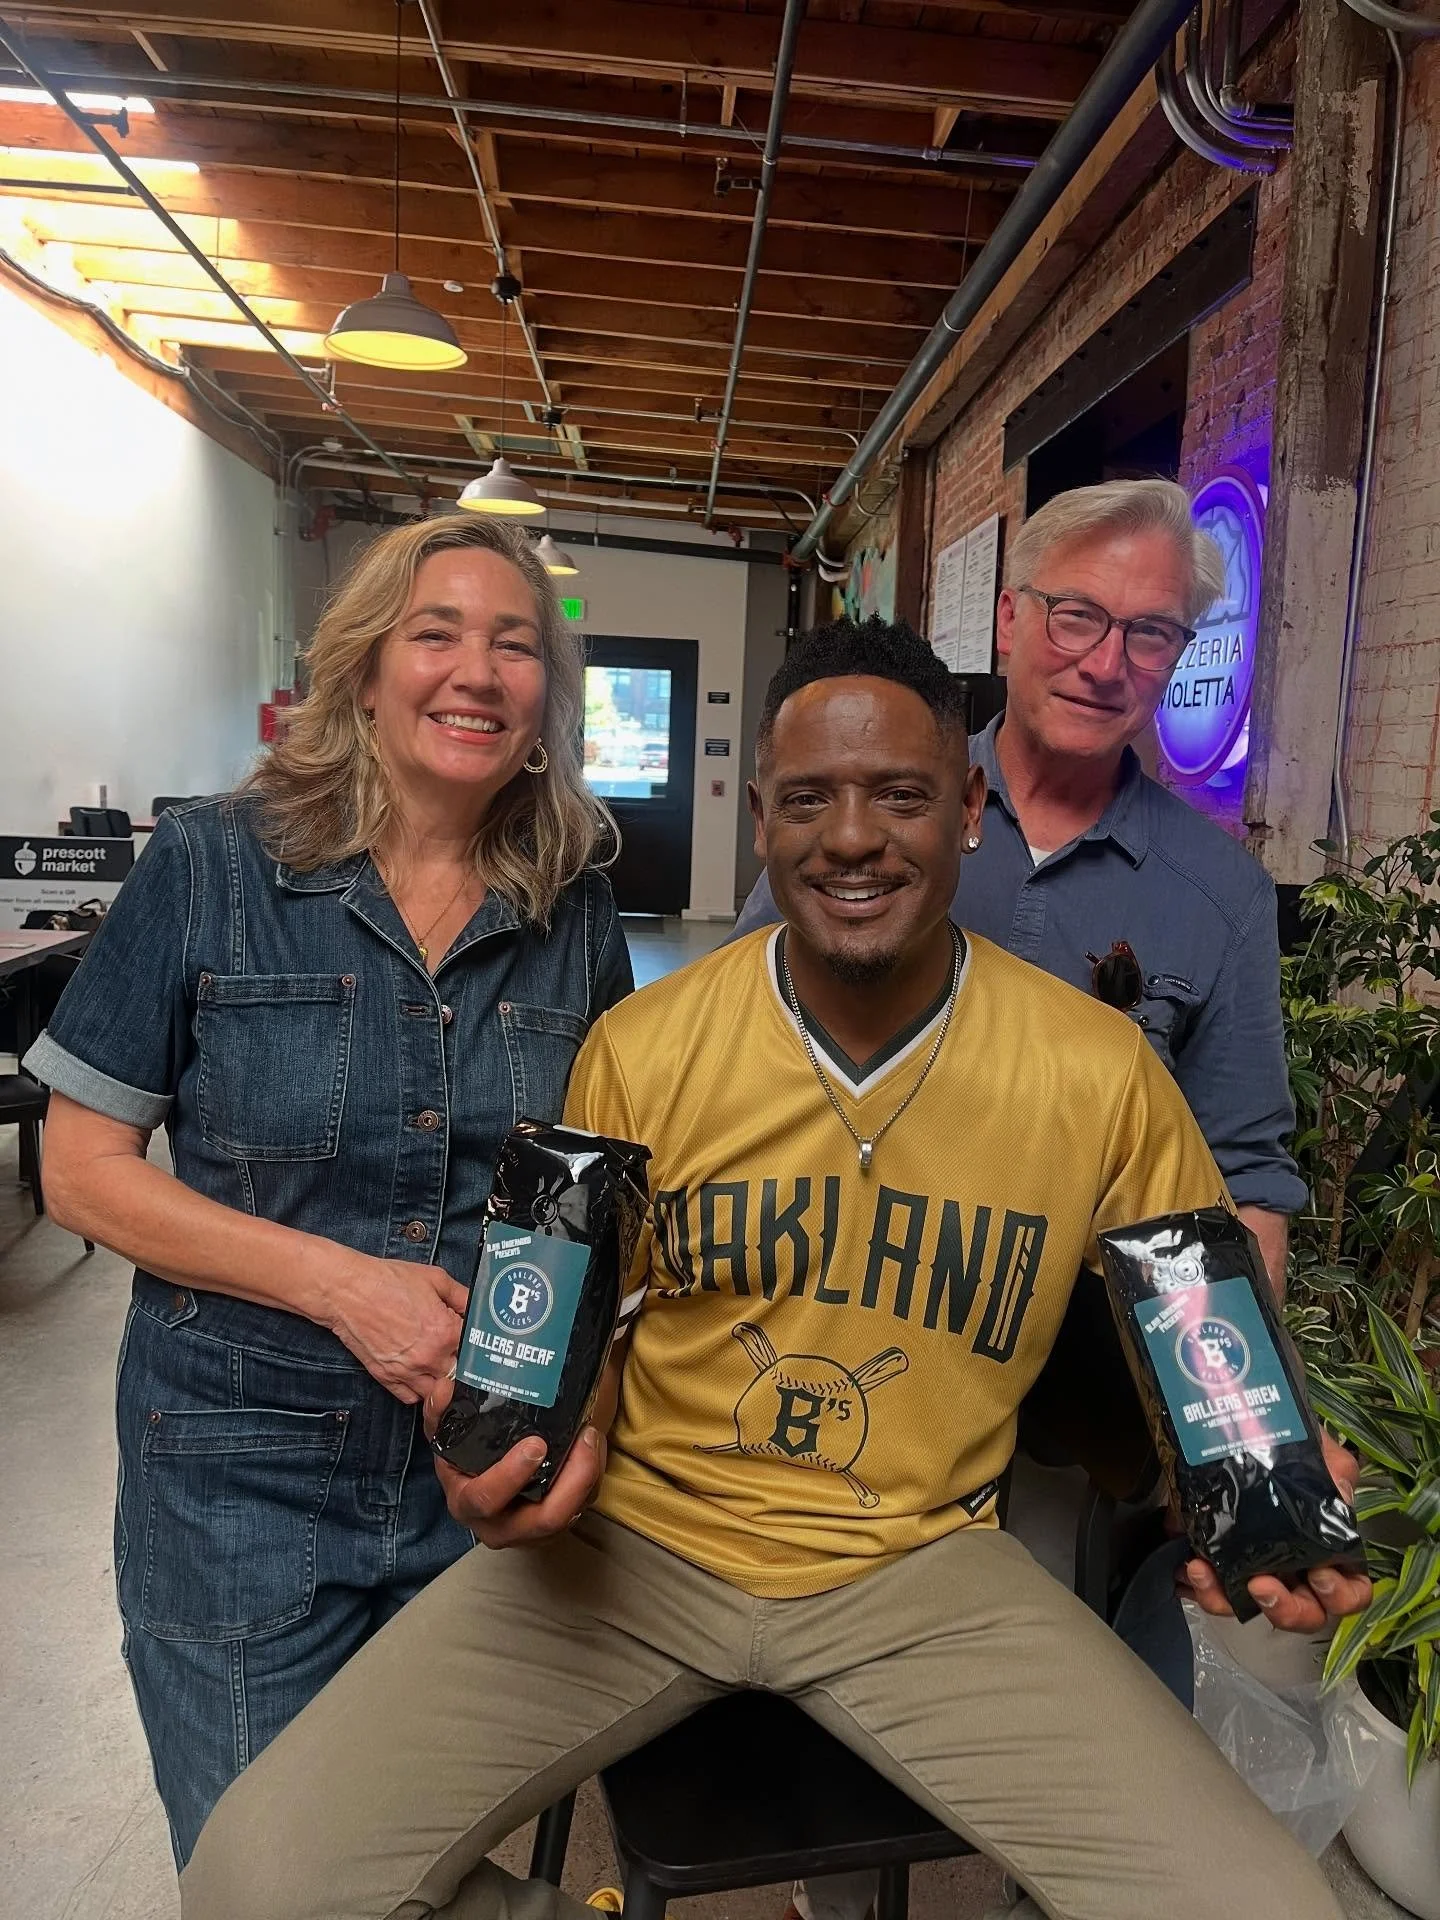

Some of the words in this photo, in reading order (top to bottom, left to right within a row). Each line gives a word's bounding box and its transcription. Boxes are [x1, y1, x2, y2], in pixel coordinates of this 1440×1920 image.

[1176, 633, 1243, 669] ZERIA
[42, 847, 106, 861] prescott
[42, 860, 96, 873] market
[507, 1271, 542, 1289] OAKLAND
[654, 1175, 1049, 1365] OAKLAND
[499, 1308, 532, 1326] BALLERS
[468, 1327, 515, 1356] BALLERS
[515, 1342, 556, 1367] DECAF
[1182, 1393, 1243, 1424] BALLERS
[1243, 1384, 1281, 1408] BREW
